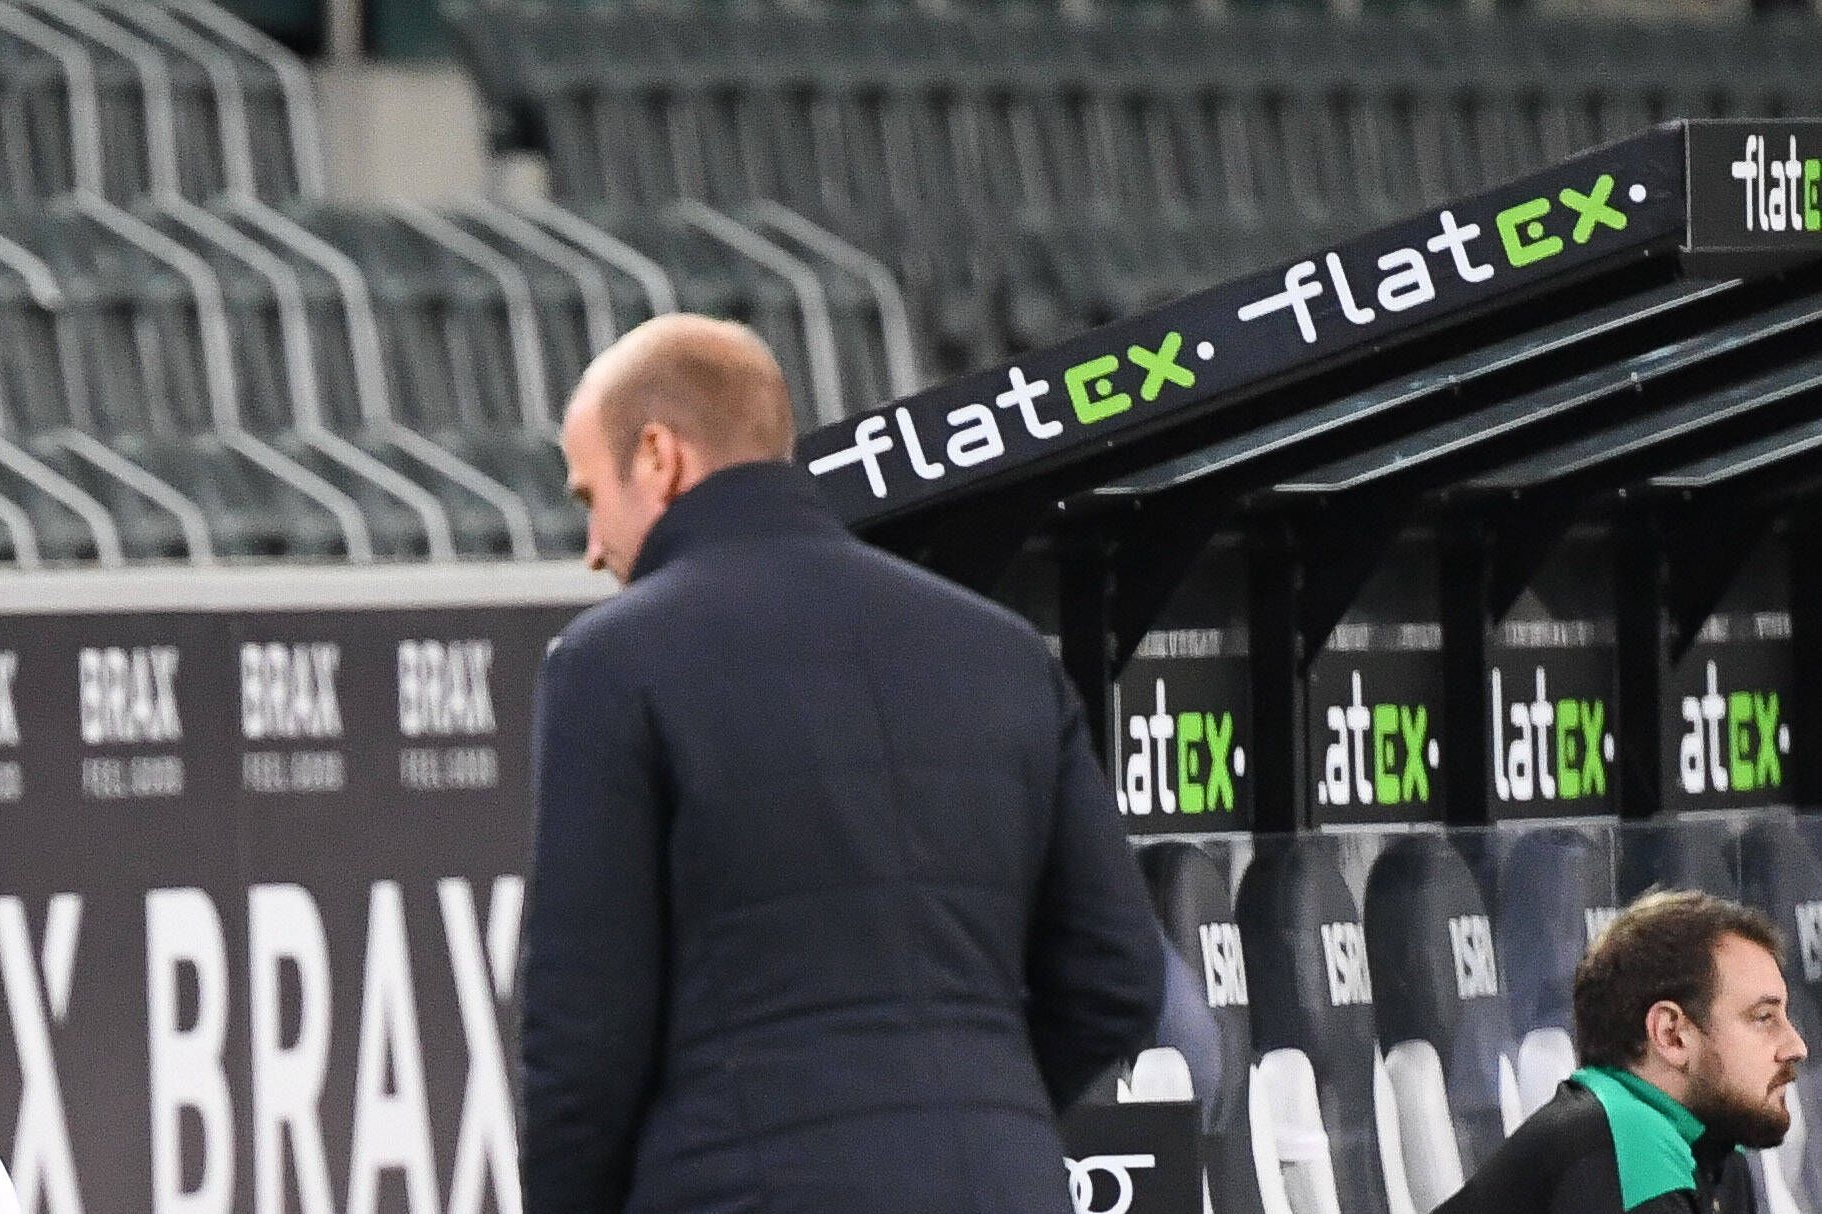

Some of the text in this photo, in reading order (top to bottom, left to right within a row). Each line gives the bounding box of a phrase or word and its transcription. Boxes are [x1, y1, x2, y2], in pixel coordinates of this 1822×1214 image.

[80, 646, 182, 745] BRAX
[239, 642, 344, 740] BRAX
[397, 639, 498, 737] BRAX
